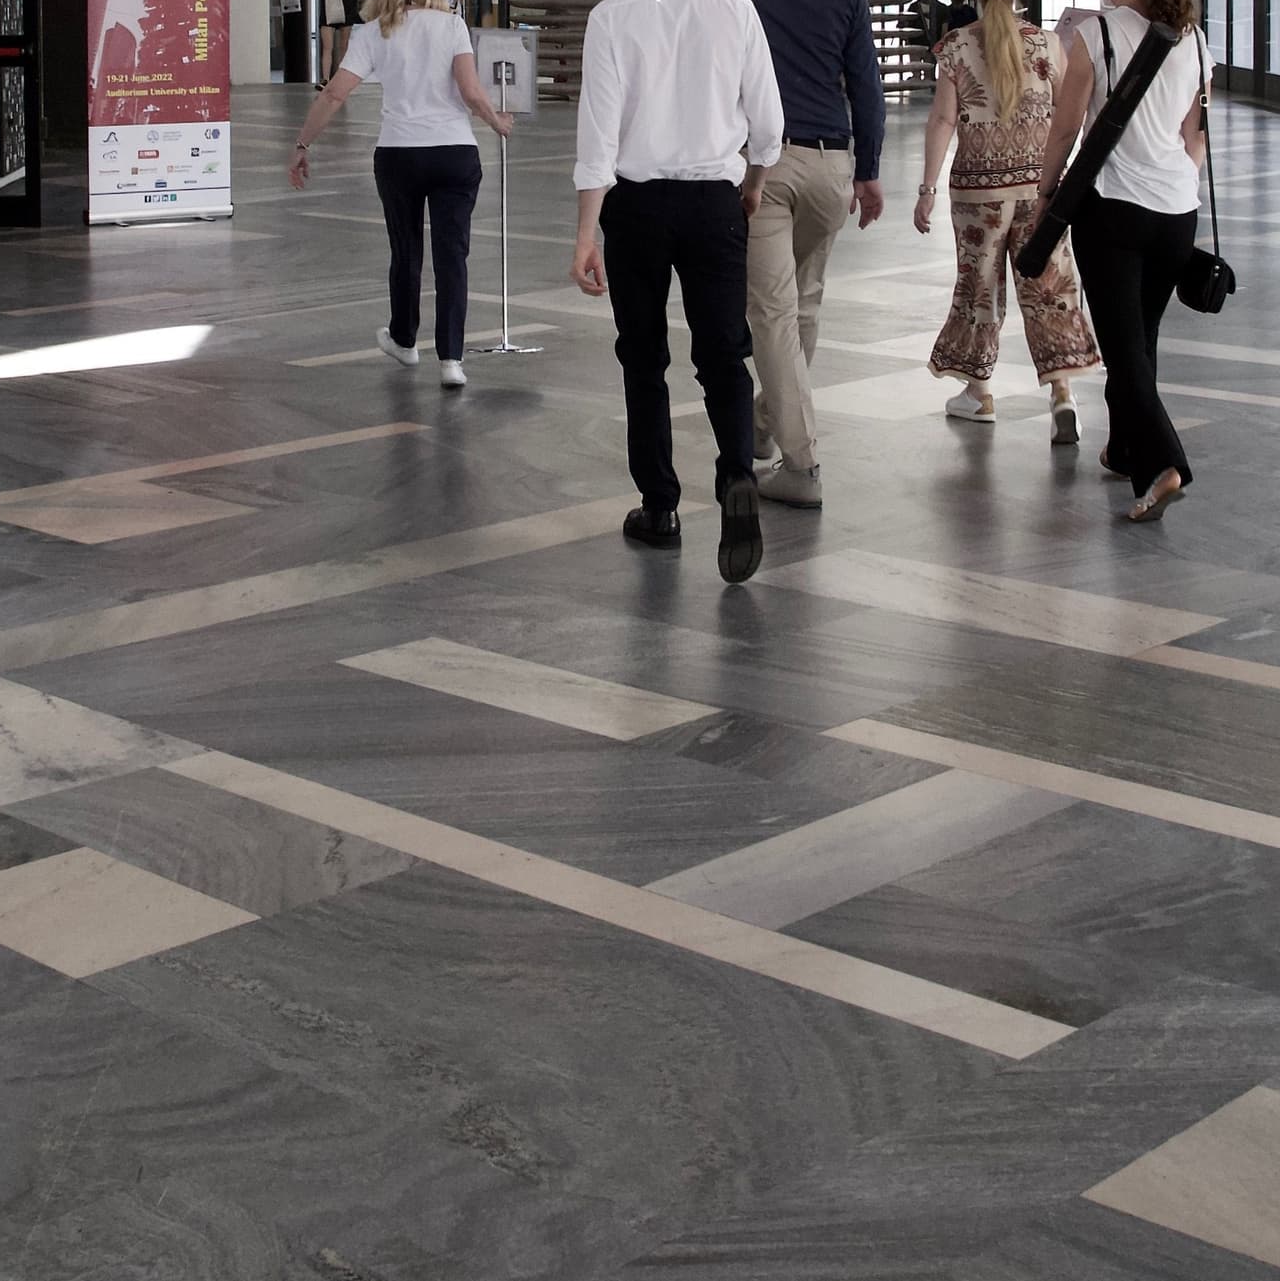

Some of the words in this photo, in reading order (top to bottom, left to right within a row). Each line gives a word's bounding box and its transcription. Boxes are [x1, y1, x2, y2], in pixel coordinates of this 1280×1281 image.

[195, 17, 208, 62] Milan
[106, 74, 128, 83] 19-21
[130, 74, 150, 82] June
[152, 73, 173, 81] 2022
[106, 88, 148, 97] Auditorium
[150, 87, 187, 96] University
[189, 86, 197, 95] of
[199, 86, 221, 94] Milan
